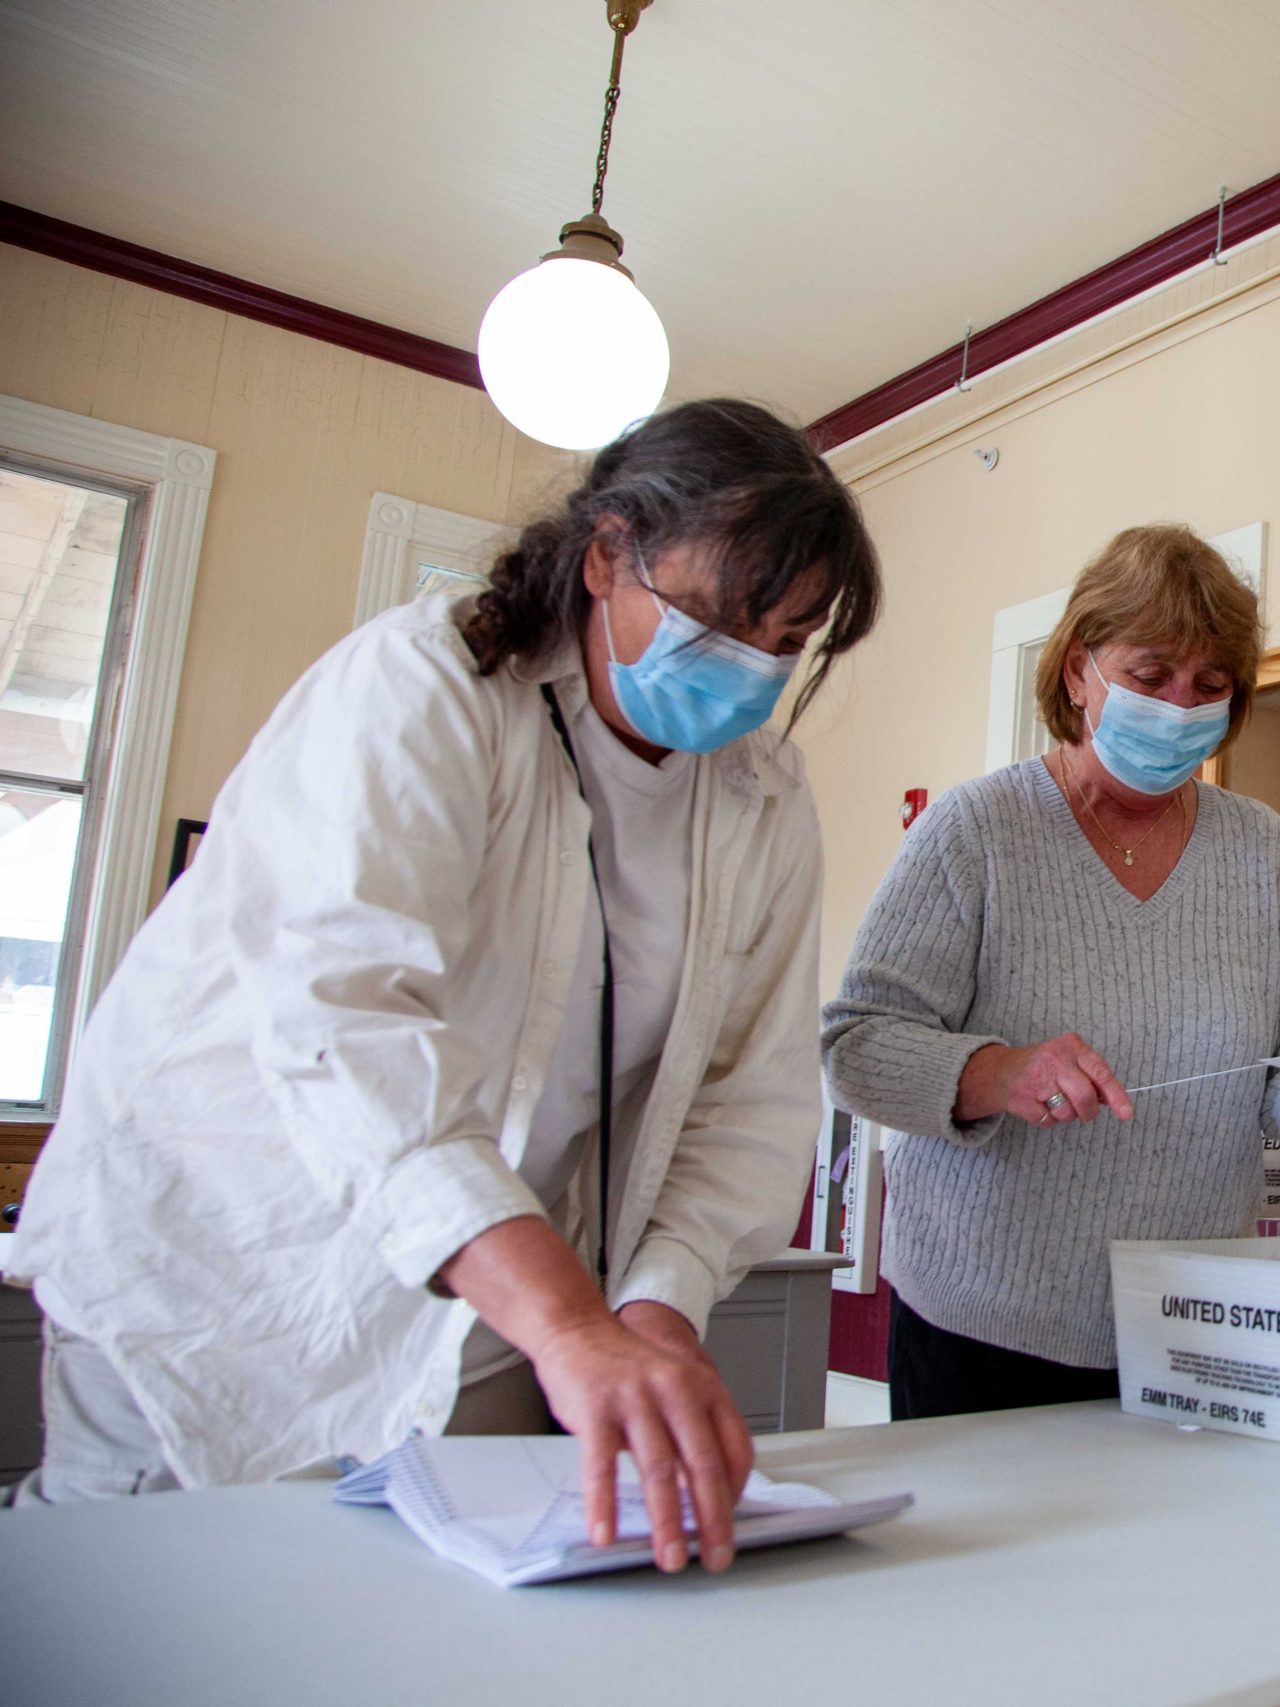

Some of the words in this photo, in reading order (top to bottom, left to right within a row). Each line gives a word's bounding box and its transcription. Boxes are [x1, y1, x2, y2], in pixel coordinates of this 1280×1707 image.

[1161, 1295, 1225, 1325] UNITED
[1141, 1386, 1167, 1408] EMM
[1168, 1392, 1200, 1414] TRAY
[1209, 1401, 1239, 1423] EIRS
[1242, 1408, 1267, 1428] 74E
